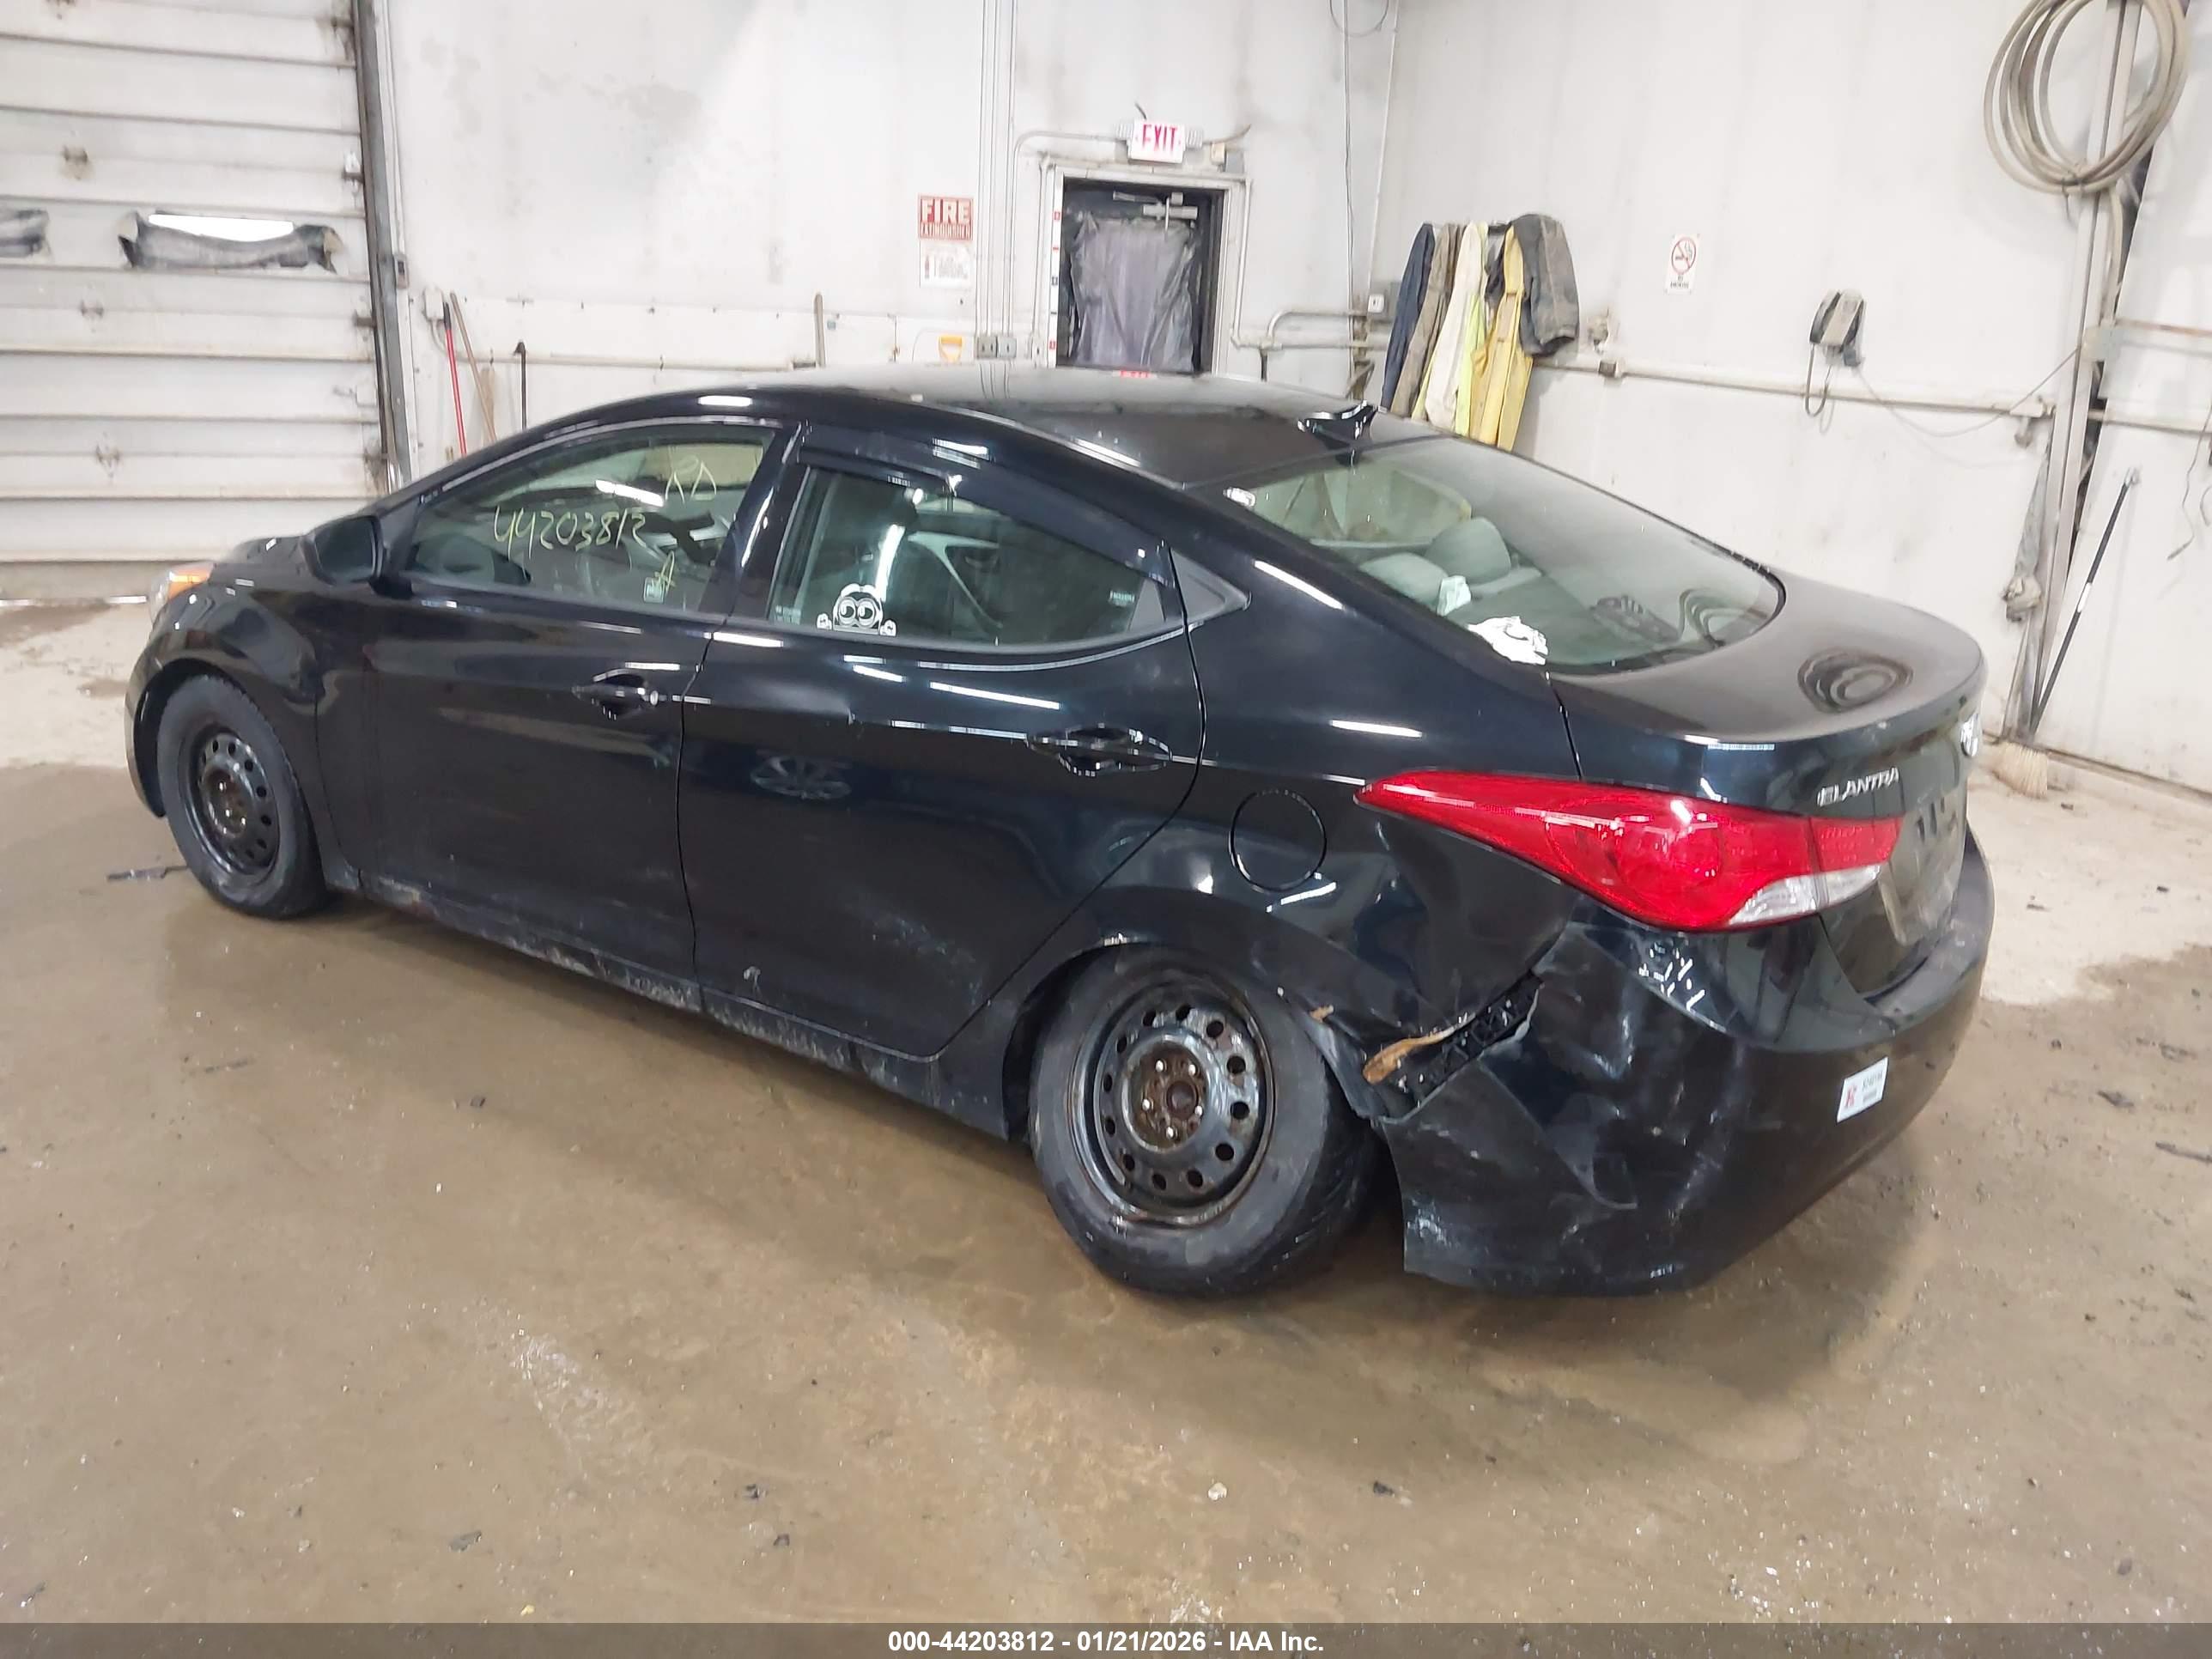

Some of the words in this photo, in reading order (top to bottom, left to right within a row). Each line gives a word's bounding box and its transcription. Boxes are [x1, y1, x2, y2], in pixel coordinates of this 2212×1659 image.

[1141, 124, 1177, 153] EXIT
[921, 198, 970, 224] FIRE
[494, 505, 661, 561] 44203812
[1816, 766, 1899, 807] ELANTRA
